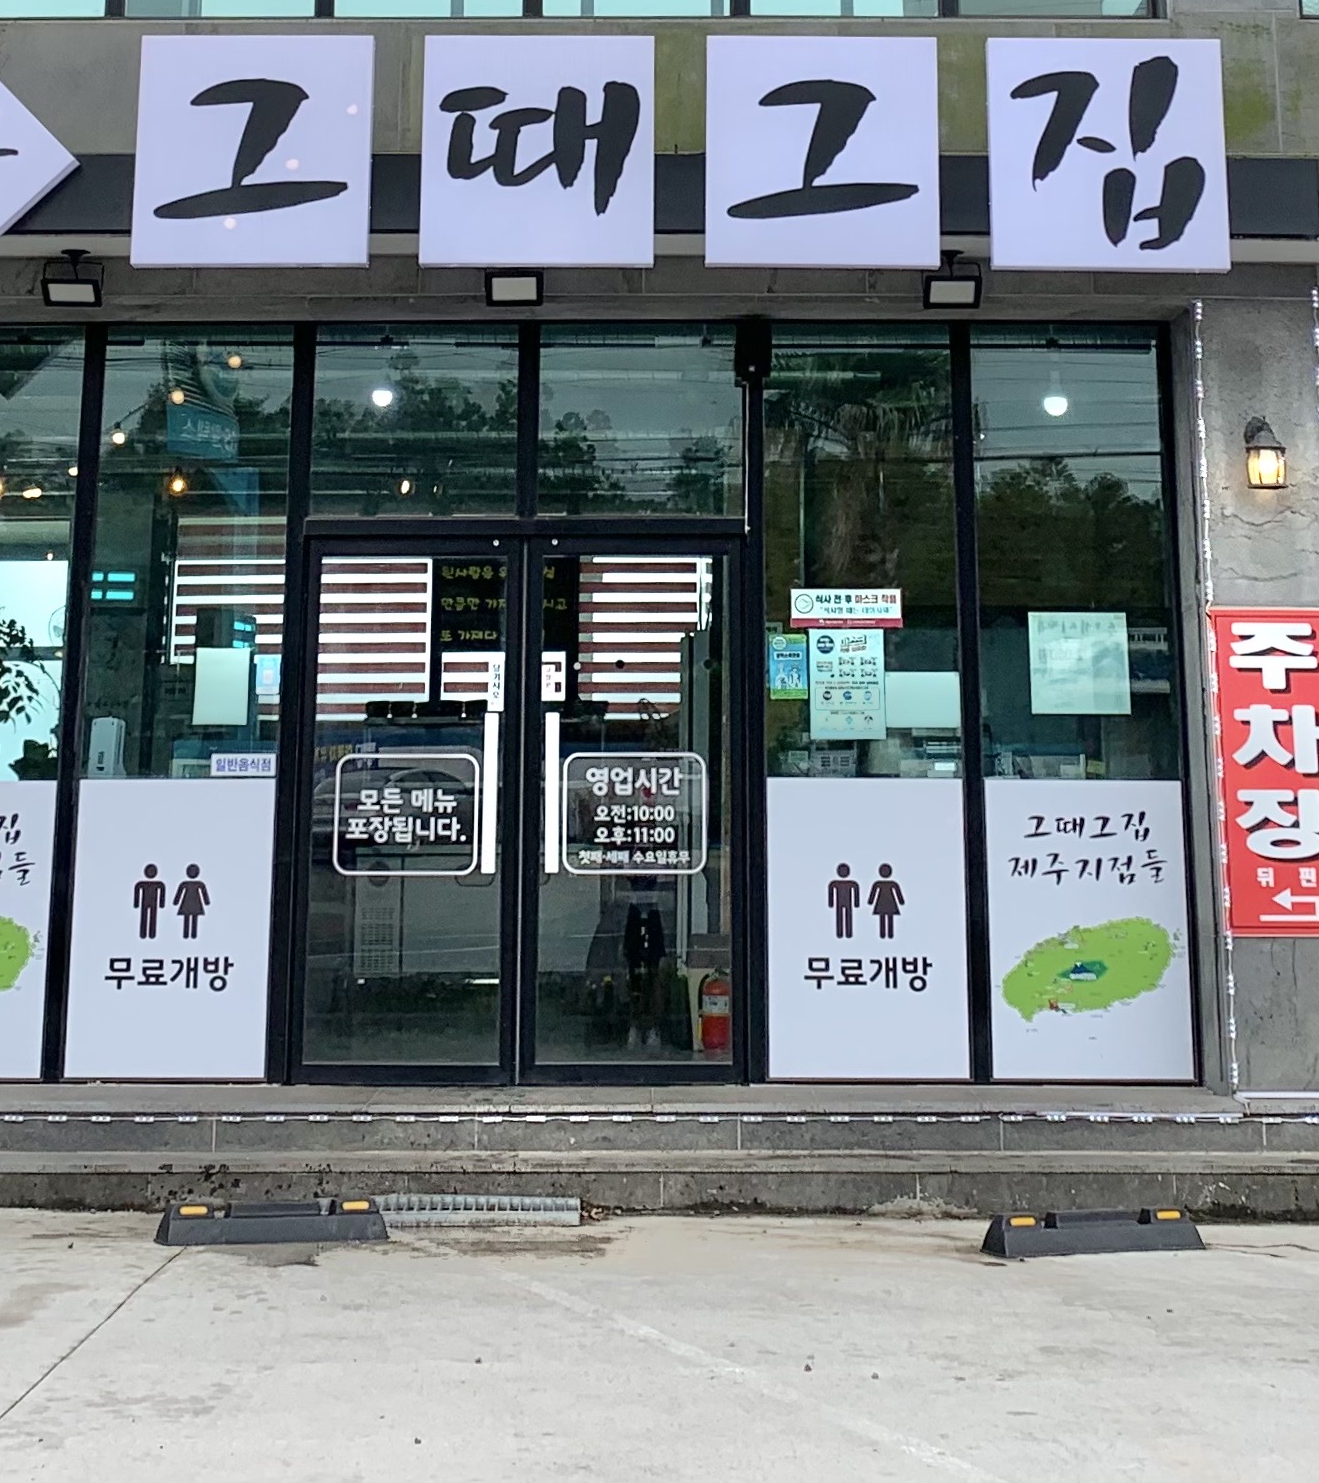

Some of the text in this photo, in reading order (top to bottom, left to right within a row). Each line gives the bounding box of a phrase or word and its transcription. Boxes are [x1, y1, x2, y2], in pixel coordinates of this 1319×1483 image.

[154, 55, 1205, 251] 그때그집
[215, 757, 272, 772] 일반음식점
[585, 767, 683, 796] 영업시간
[357, 788, 457, 814] 모든 메뉴
[594, 805, 675, 823] 오전:10:00
[345, 816, 467, 844] 포장됩니다.
[594, 827, 675, 845] 오후:11:00
[1024, 811, 1151, 843] 그때그집
[104, 956, 235, 992] 무료개방
[803, 956, 933, 992] 무료개방
